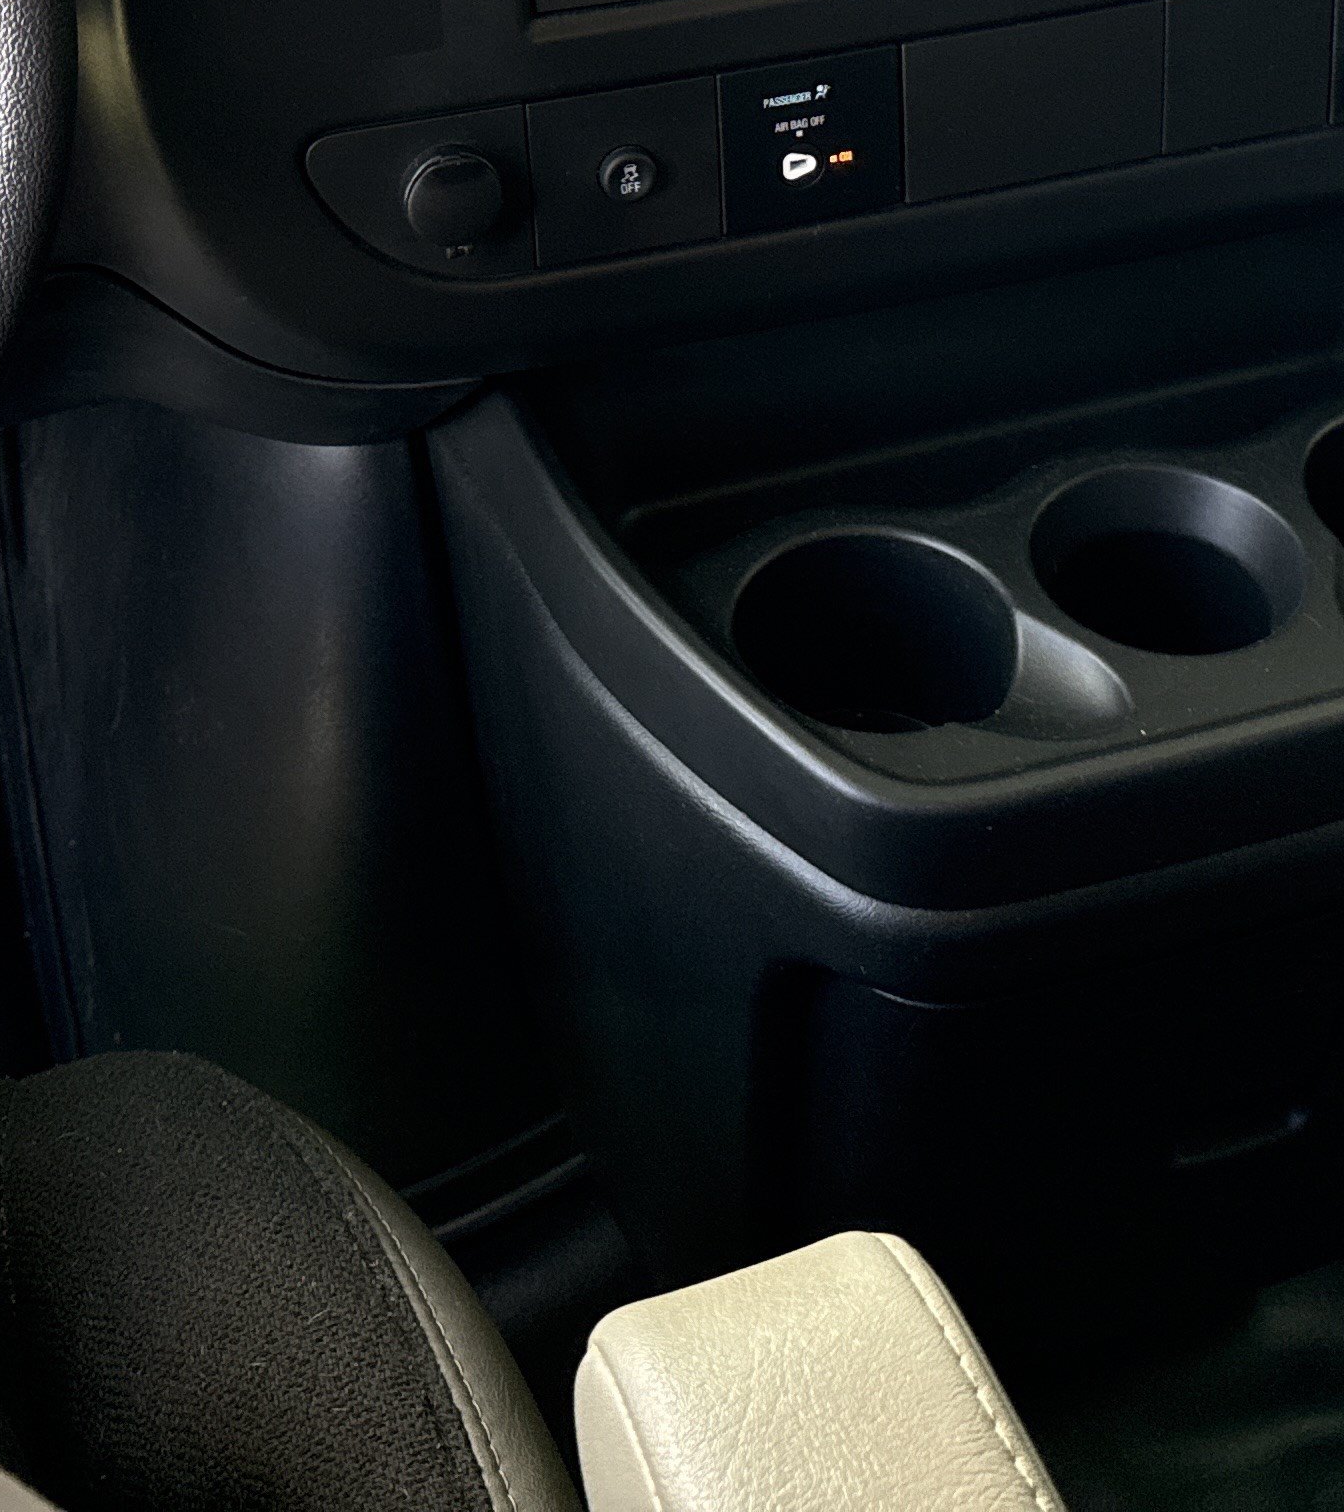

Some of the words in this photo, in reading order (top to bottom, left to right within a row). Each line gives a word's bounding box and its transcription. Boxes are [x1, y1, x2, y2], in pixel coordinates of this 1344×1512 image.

[763, 92, 812, 108] PASSENGER
[775, 122, 789, 133] AIR
[790, 118, 808, 130] BAG
[810, 115, 825, 127] OFF
[620, 181, 641, 195] OFF
